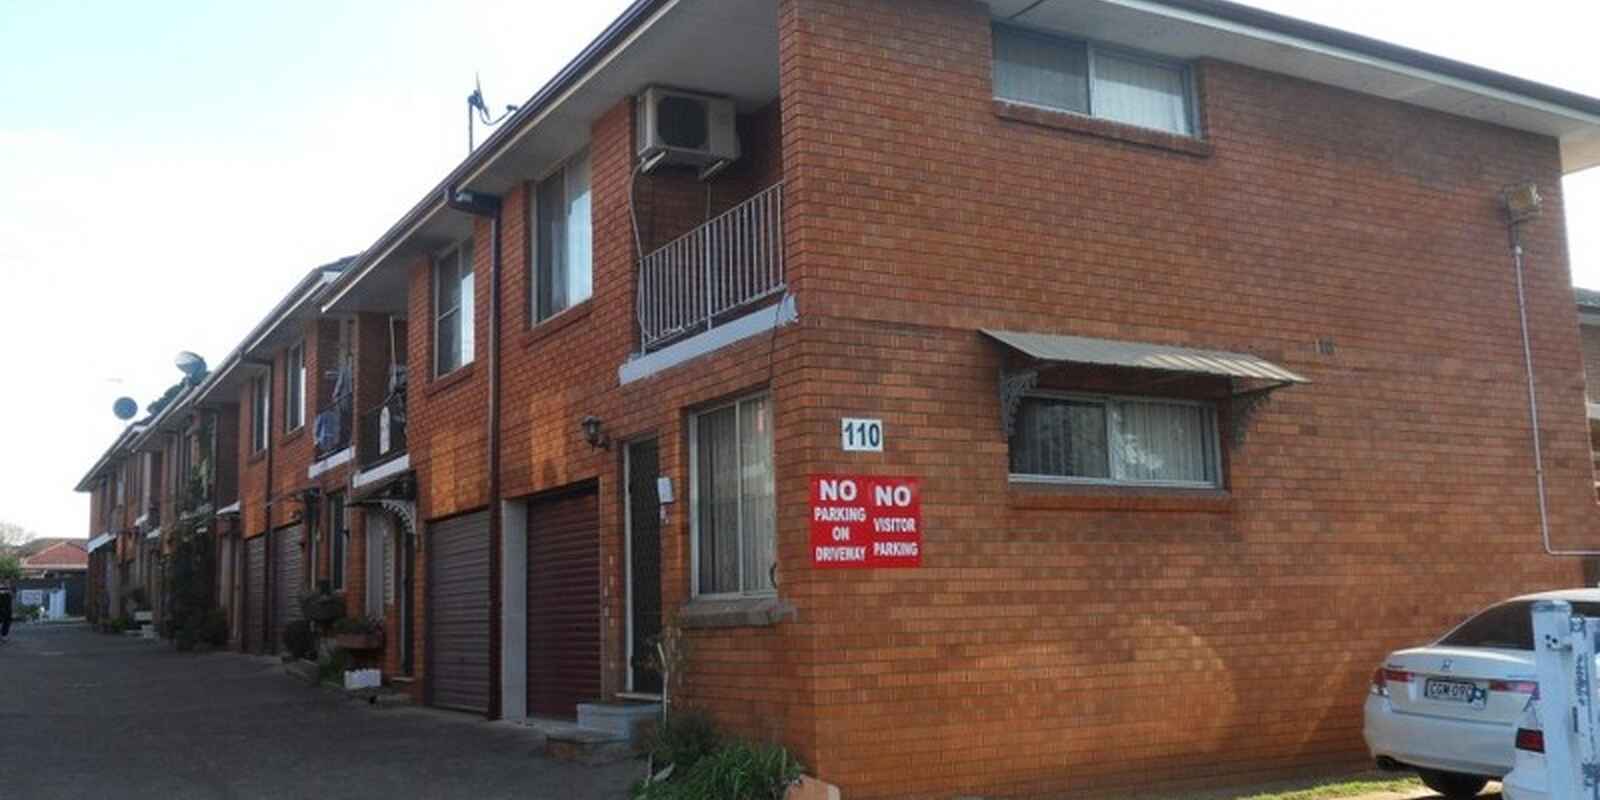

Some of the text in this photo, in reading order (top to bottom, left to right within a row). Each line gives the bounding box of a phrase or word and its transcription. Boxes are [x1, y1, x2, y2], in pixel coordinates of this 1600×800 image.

[844, 422, 880, 447] 110
[819, 479, 857, 501] NO
[875, 485, 912, 507] NO
[814, 506, 866, 521] PARKING
[873, 518, 915, 533] VISITOR
[832, 526, 850, 541] ON
[815, 546, 866, 562] DRIVEWAY
[873, 542, 918, 556] PARKING
